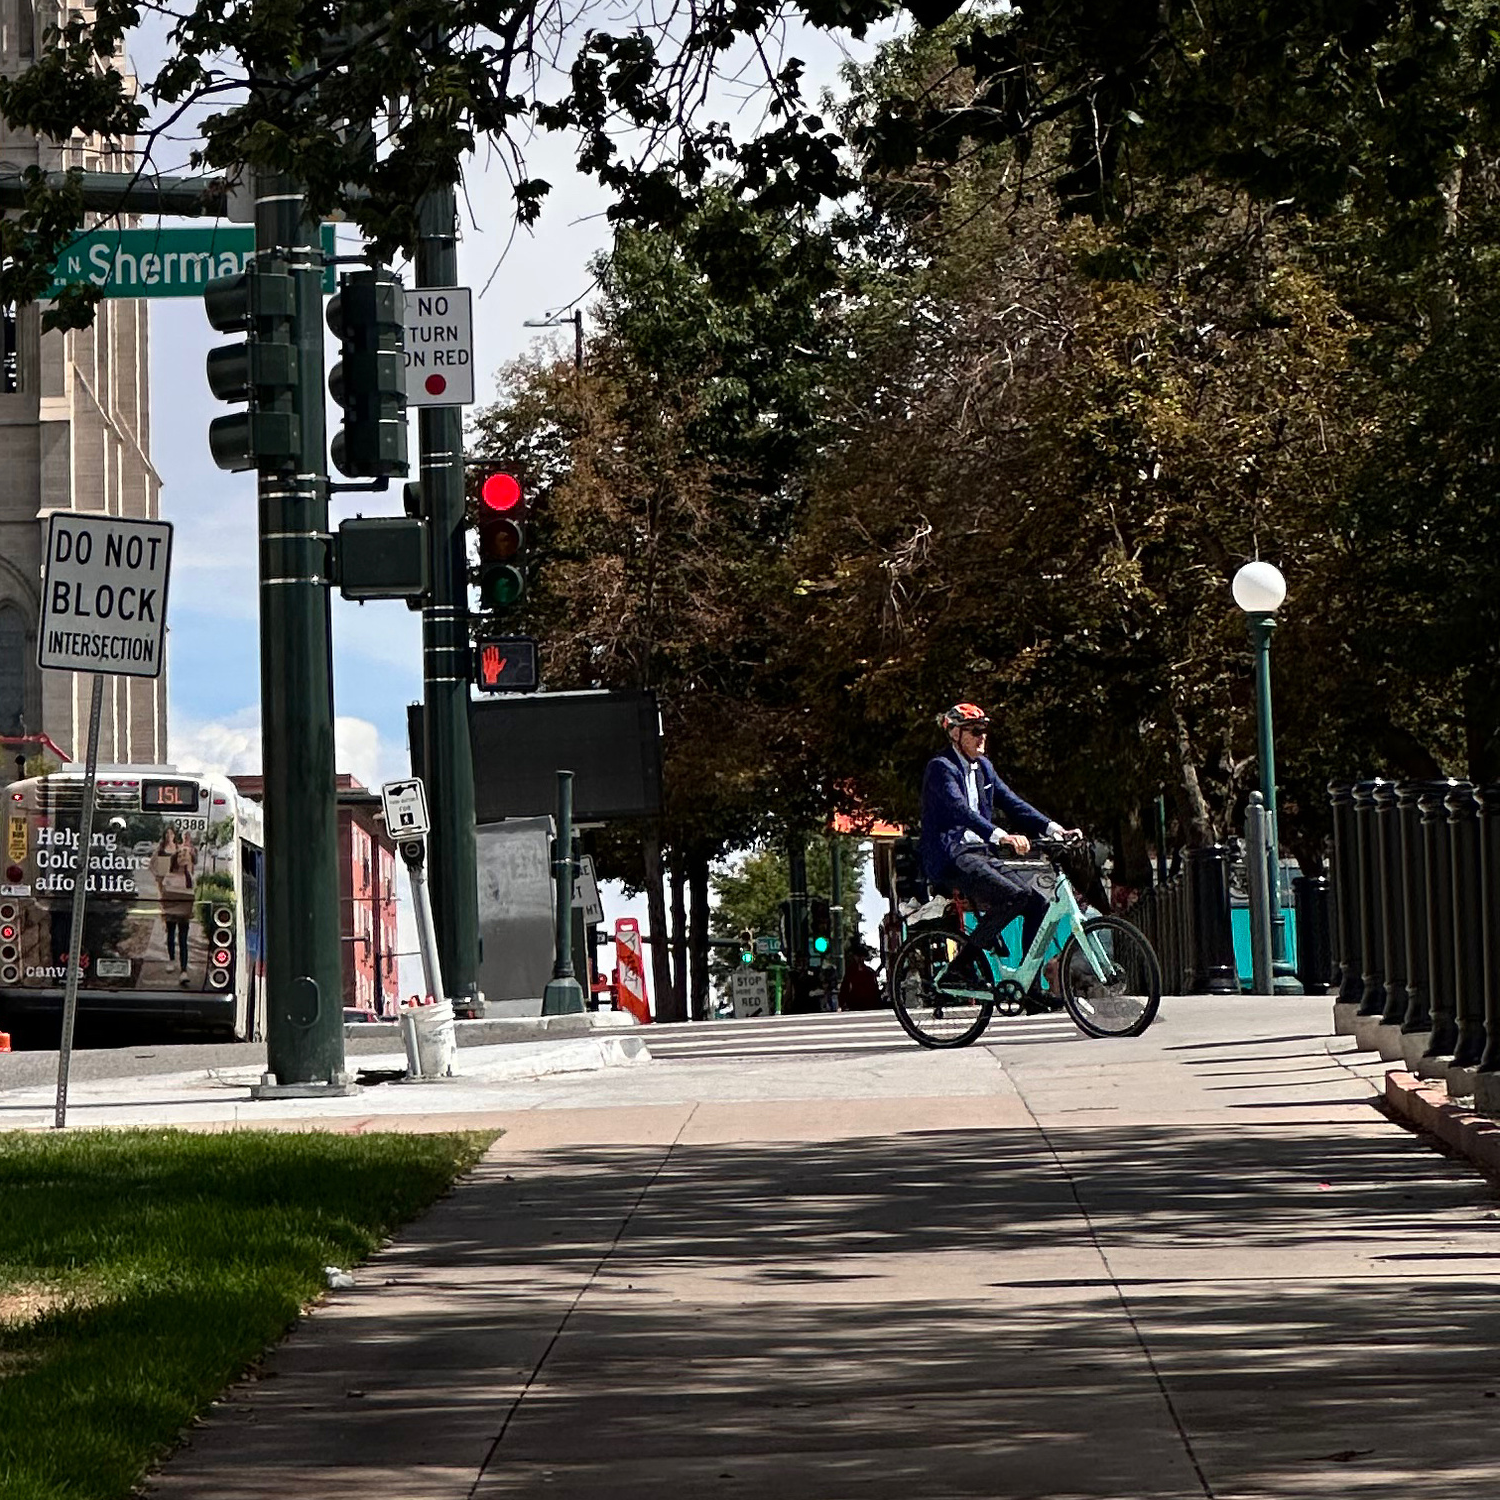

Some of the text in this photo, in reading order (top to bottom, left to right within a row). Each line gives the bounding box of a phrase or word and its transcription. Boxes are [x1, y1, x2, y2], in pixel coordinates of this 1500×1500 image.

[68, 256, 80, 274] N
[418, 296, 449, 317] NO
[409, 326, 458, 342] TURN
[433, 348, 469, 366] RED
[55, 529, 162, 571] DO NOT
[52, 580, 157, 622] BLOCK
[48, 630, 155, 662] INTERSECTION
[157, 786, 183, 804] 15L
[175, 818, 205, 831] 9388
[37, 827, 117, 851] Helpng
[36, 850, 151, 870] Coloadans
[35, 873, 96, 891] affod
[100, 875, 139, 892] life.
[26, 966, 84, 979] canvs
[737, 975, 761, 986] STOP
[741, 996, 760, 1007] RED
